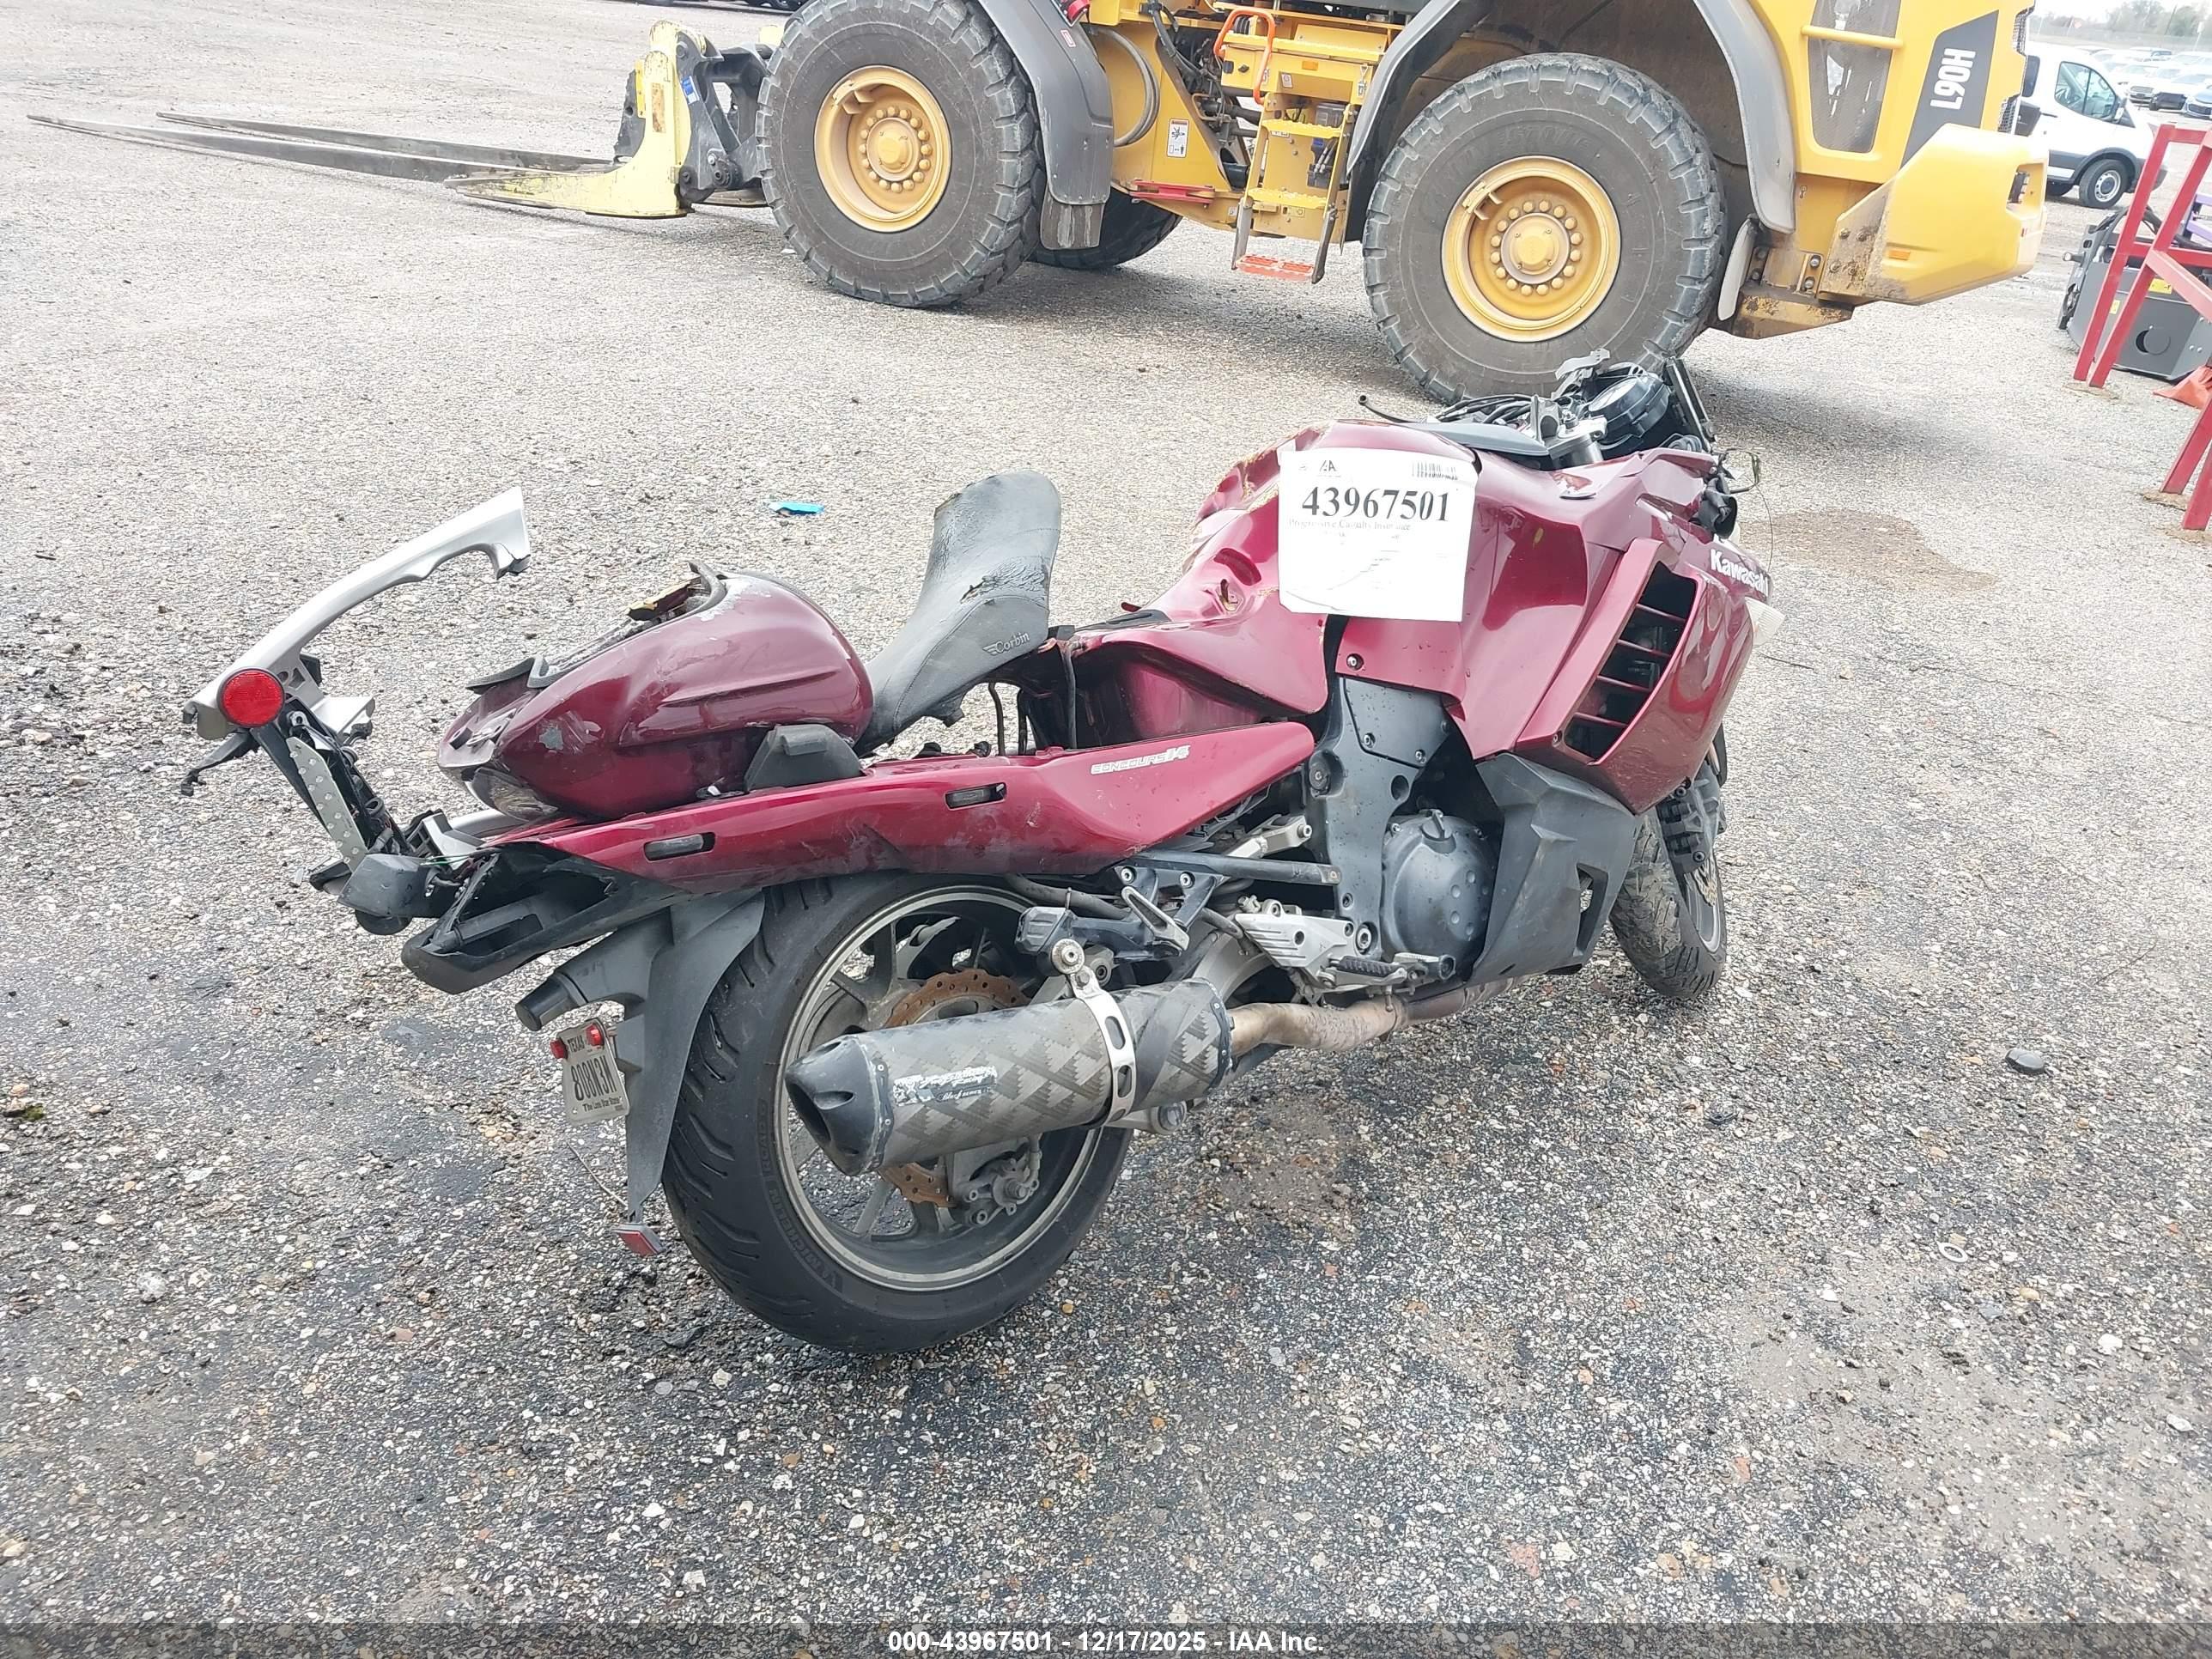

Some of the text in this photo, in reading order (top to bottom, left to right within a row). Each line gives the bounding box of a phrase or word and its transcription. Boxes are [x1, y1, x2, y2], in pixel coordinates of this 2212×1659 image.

[1929, 47, 1977, 111] L90H
[1301, 485, 1449, 522] 43967501
[995, 631, 1030, 653] Corbin
